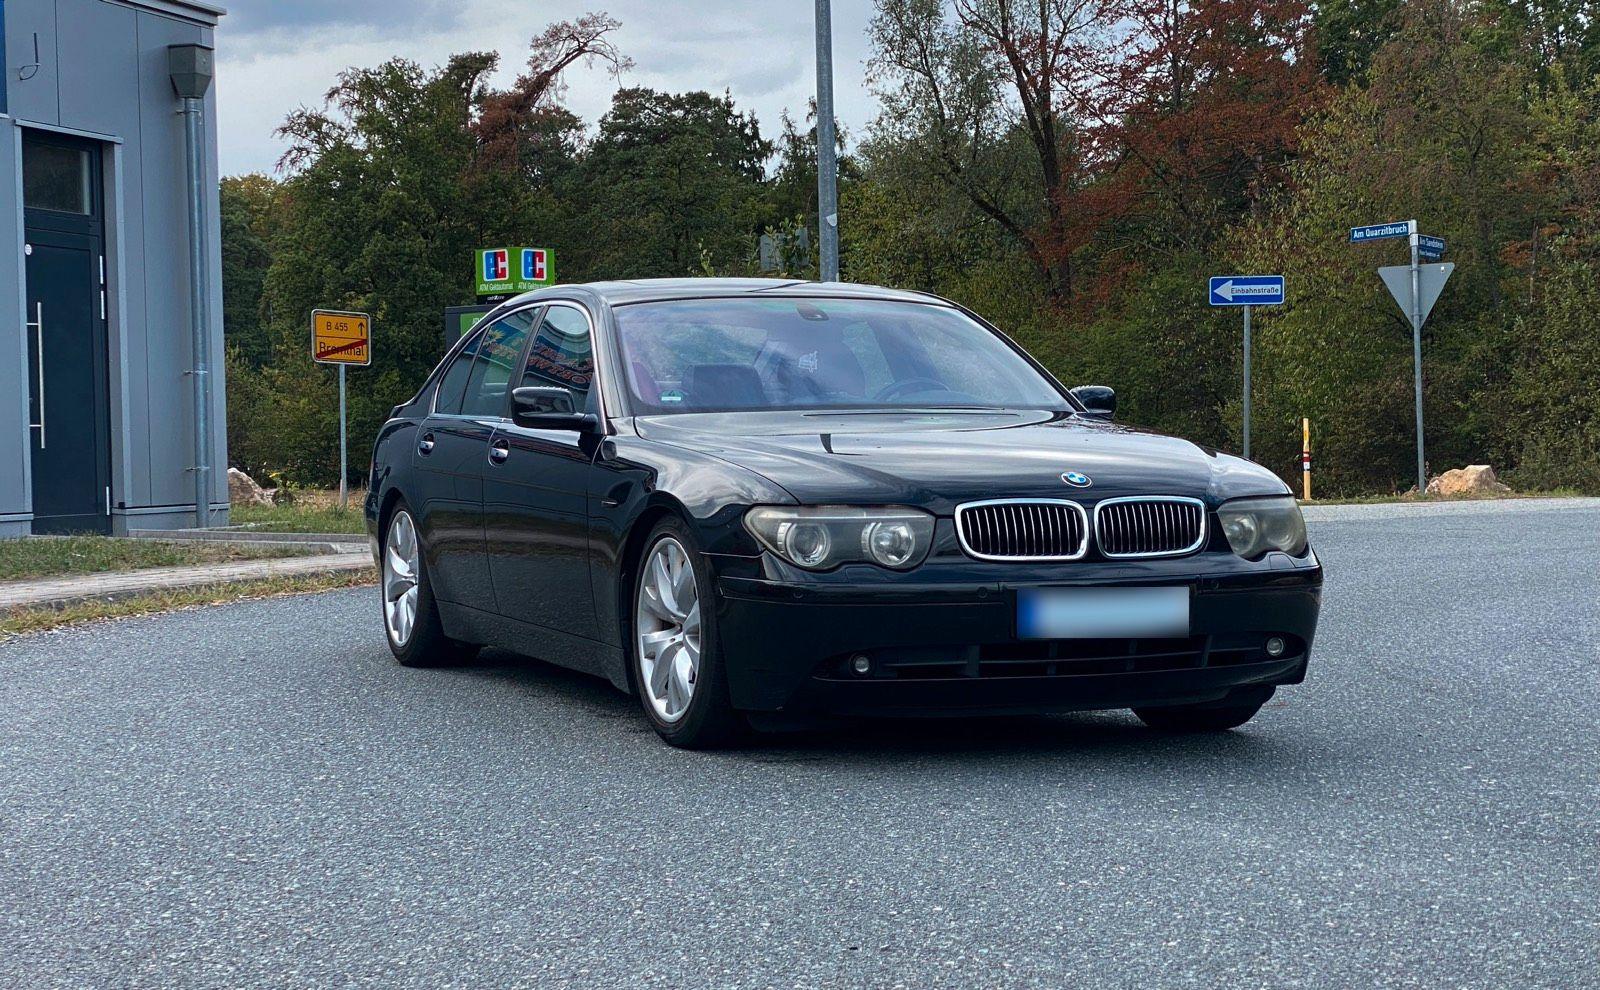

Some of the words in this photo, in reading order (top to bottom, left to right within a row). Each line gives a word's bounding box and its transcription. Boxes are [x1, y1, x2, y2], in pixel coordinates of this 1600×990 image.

[1353, 229, 1364, 239] Am
[1365, 224, 1408, 237] Quarzitbruch
[327, 321, 332, 331] B
[334, 322, 349, 331] 455
